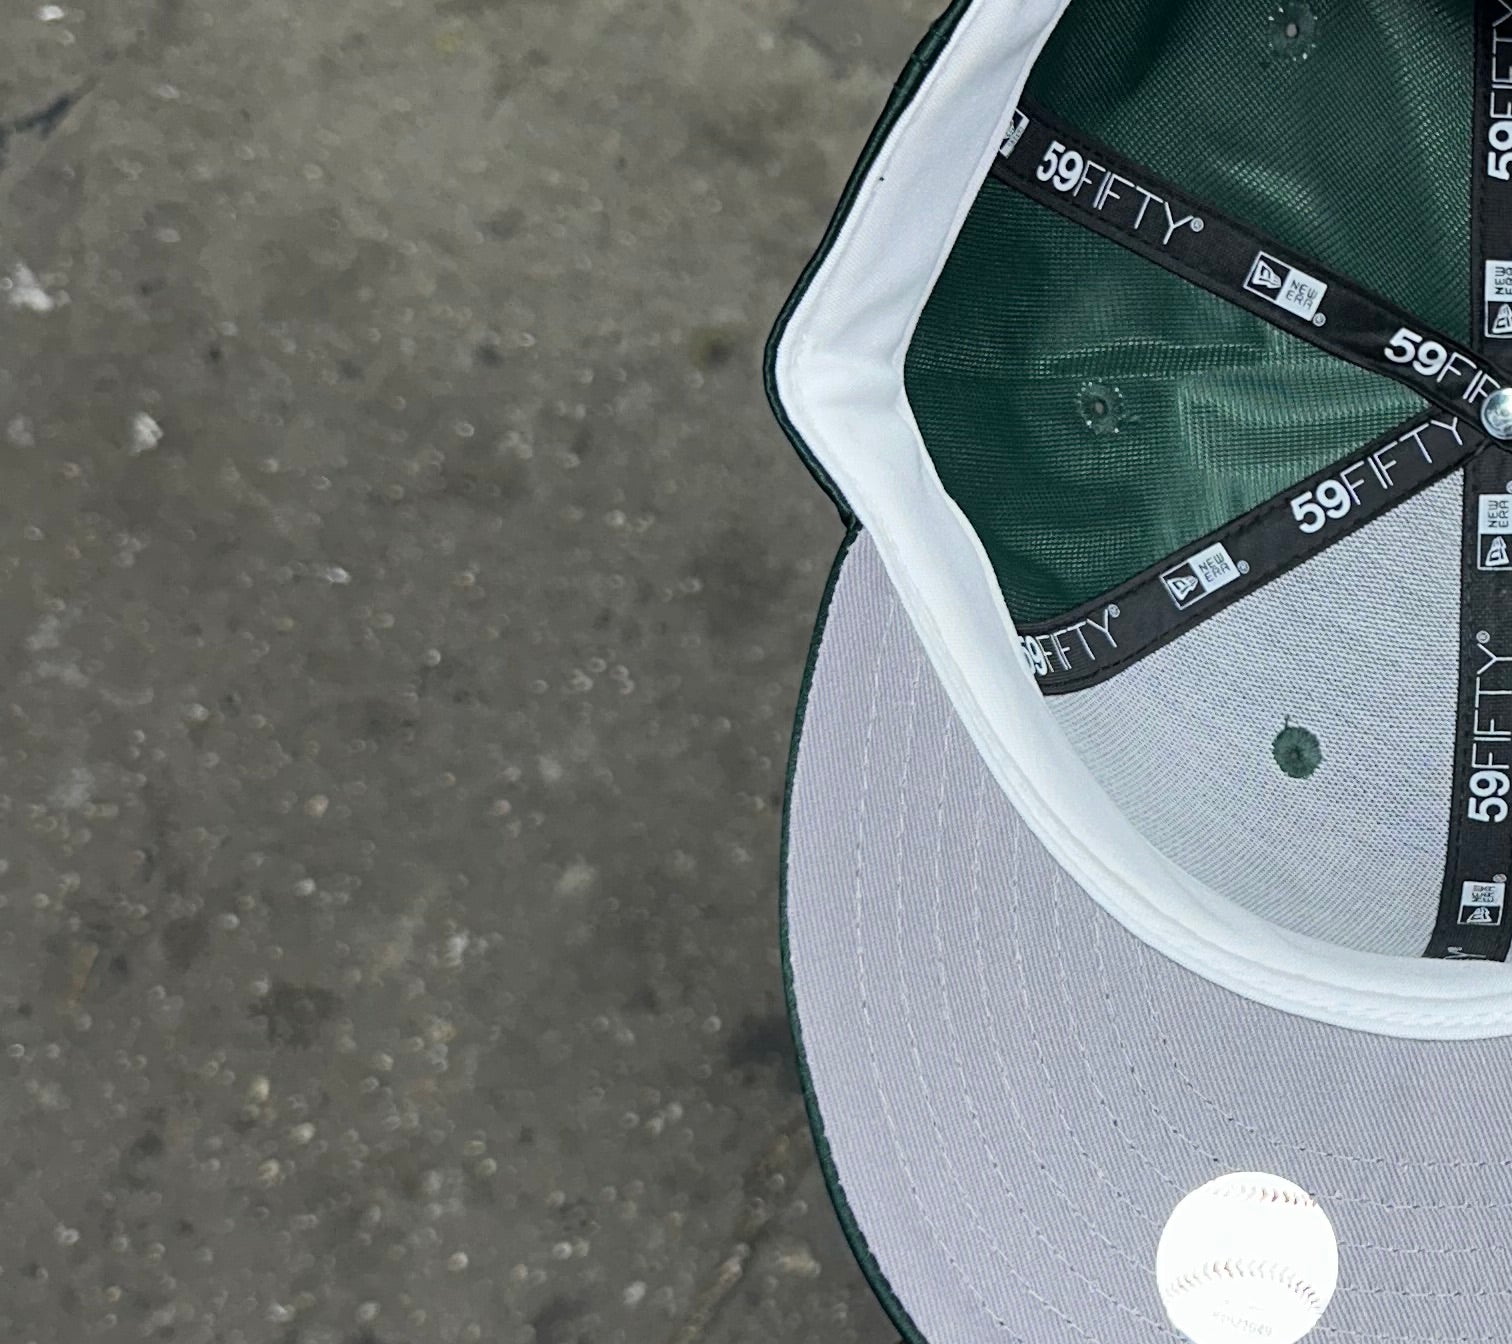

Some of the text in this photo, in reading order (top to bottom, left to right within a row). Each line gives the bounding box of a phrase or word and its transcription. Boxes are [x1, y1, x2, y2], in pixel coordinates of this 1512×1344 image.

[1291, 279, 1318, 299] NEW
[1494, 266, 1506, 295] NEW
[1286, 290, 1314, 310] ERA
[1488, 500, 1499, 528] NEW
[1498, 500, 1509, 528] ERA
[1198, 552, 1225, 573] NEW
[1204, 562, 1231, 582] ERA
